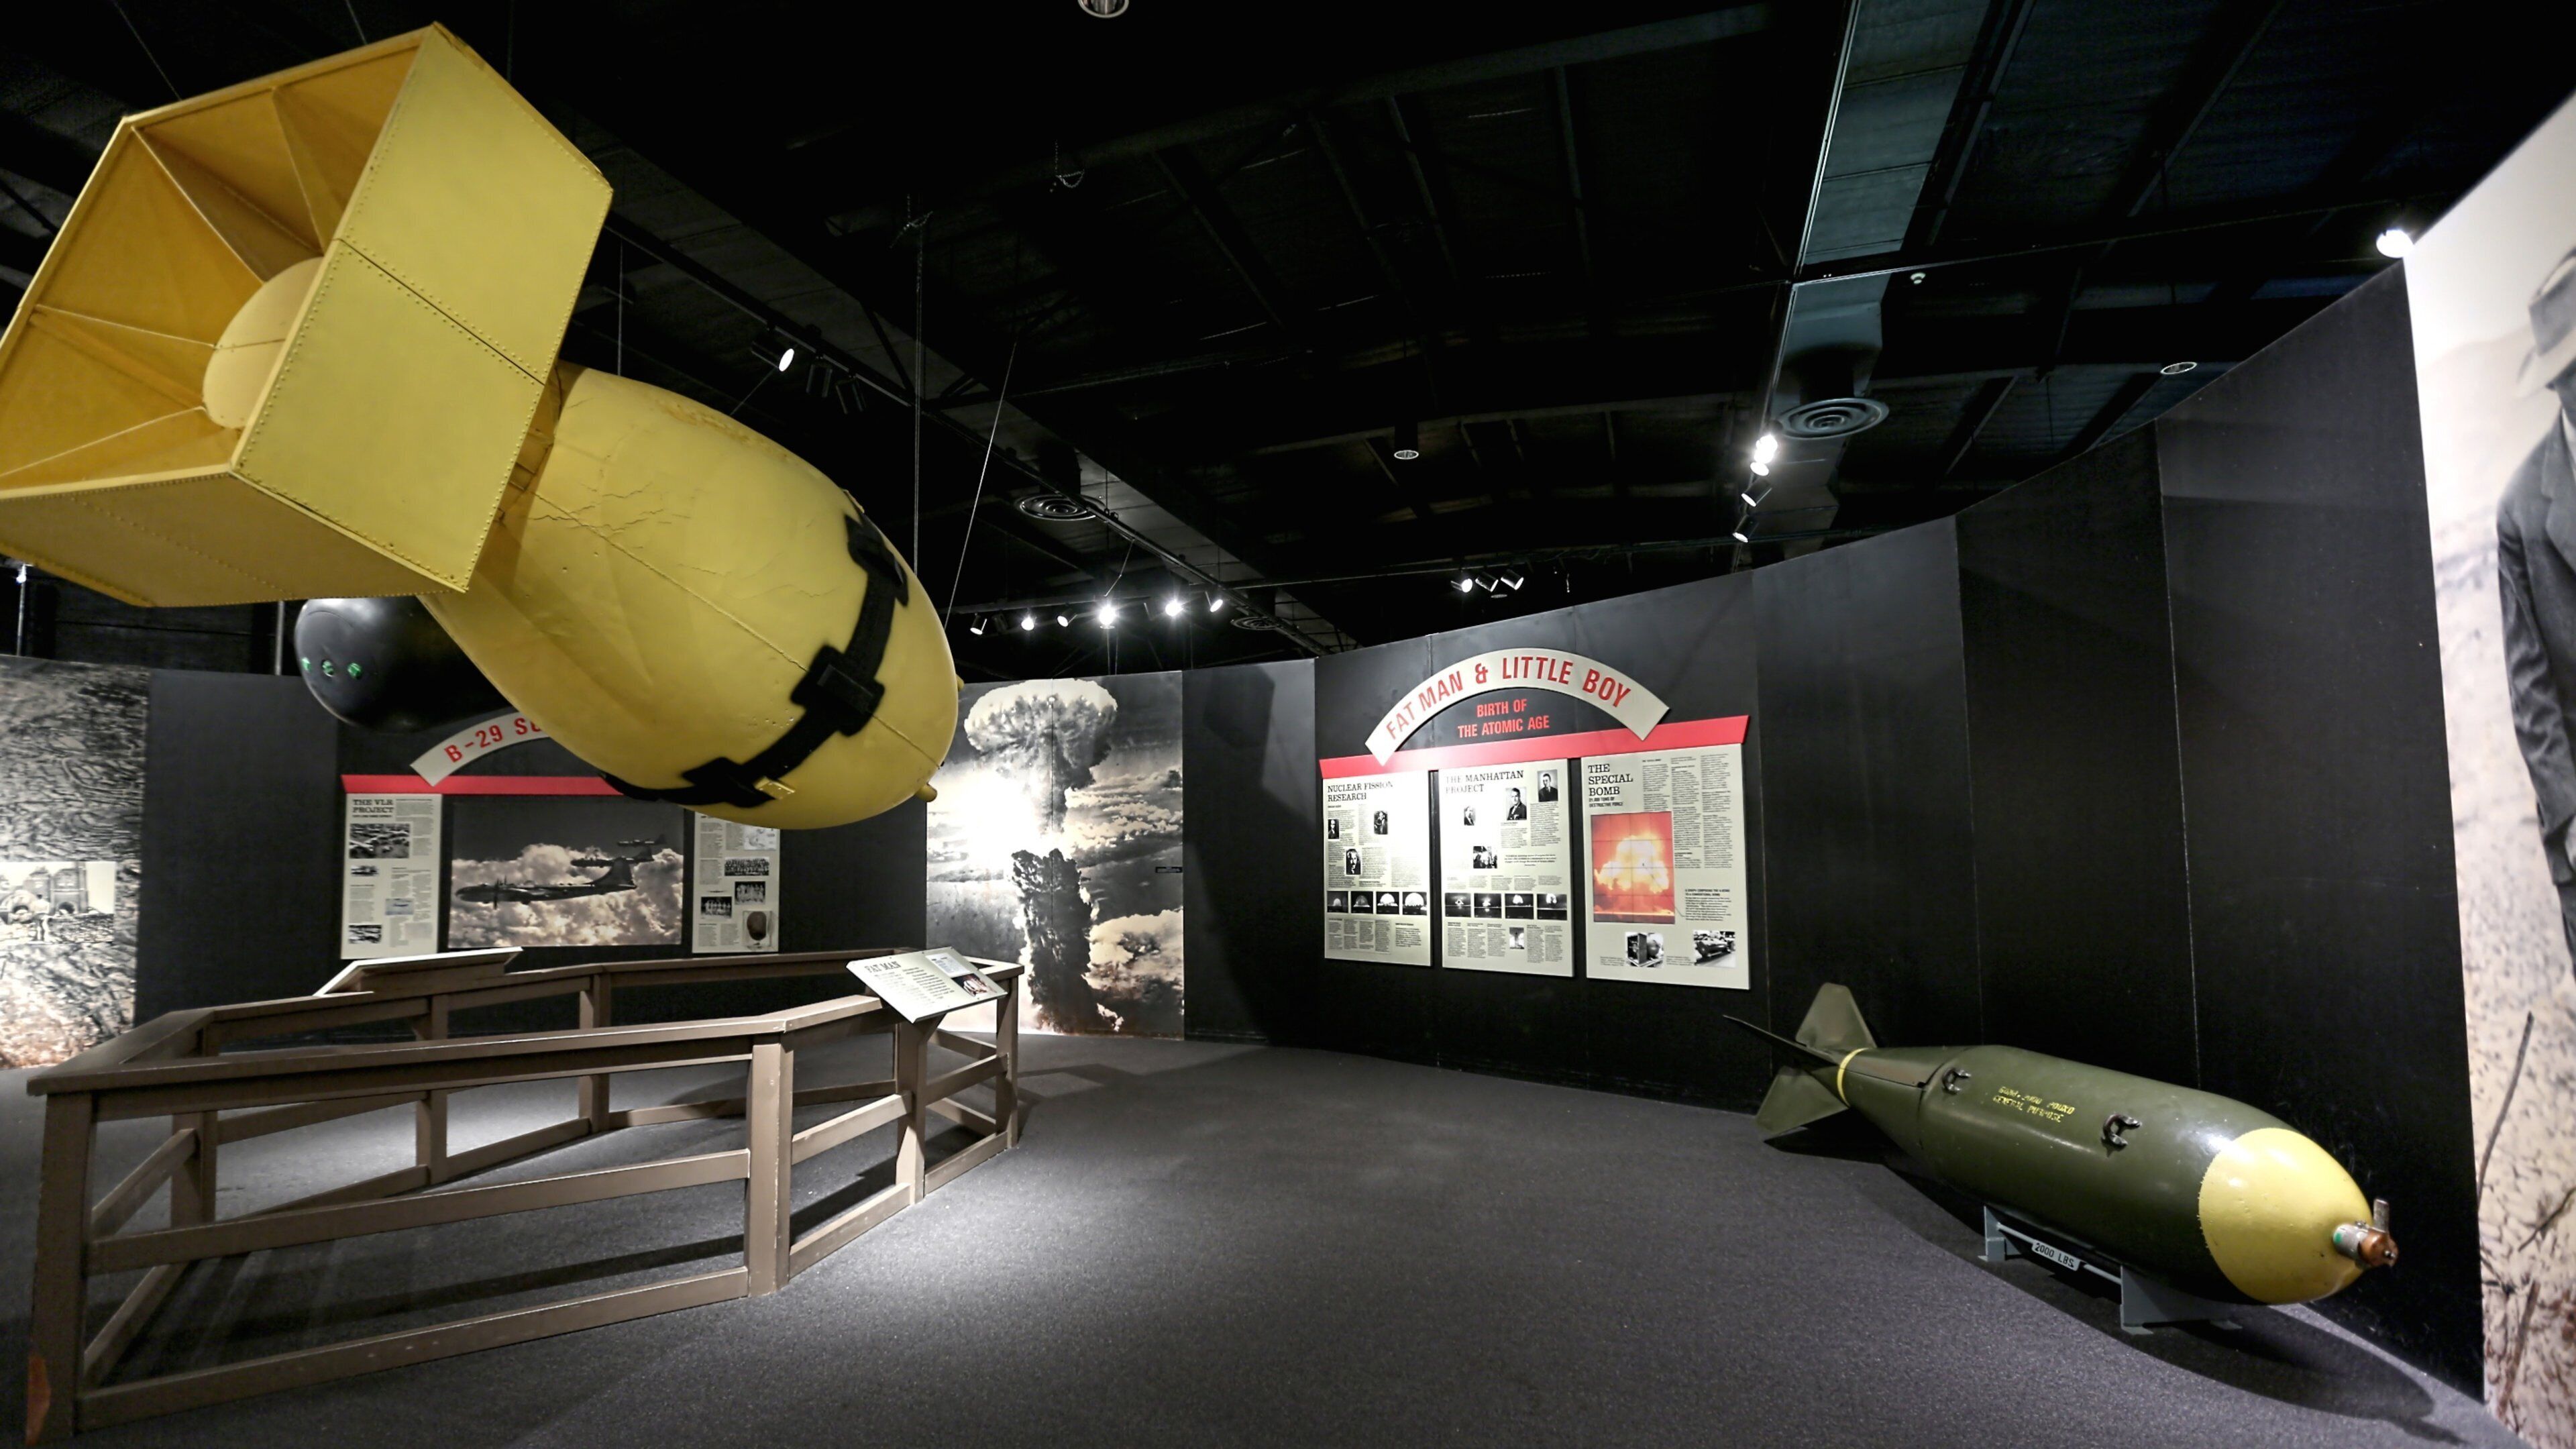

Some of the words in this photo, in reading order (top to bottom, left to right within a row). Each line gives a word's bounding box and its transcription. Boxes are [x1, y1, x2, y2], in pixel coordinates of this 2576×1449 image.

[1385, 701, 1416, 740] FAT
[1417, 671, 1464, 709] MAN
[1475, 663, 1488, 684] &
[1502, 657, 1574, 685] LITTLE
[1582, 669, 1632, 708] BOY
[1477, 701, 1509, 718] BIRTH
[1513, 699, 1527, 713] OF
[1458, 724, 1477, 738] THE
[1481, 720, 1523, 736] ATOMIC
[1527, 716, 1550, 729] AGE
[444, 724, 502, 762] B-29
[1589, 763, 1610, 773] THE
[1446, 775, 1464, 784] THE
[1465, 770, 1523, 782] MANHATTAN
[1589, 773, 1633, 785] SPECIAL
[1328, 783, 1362, 793] NUCLEAR
[1364, 781, 1393, 790] FISSION
[1445, 784, 1484, 794] PROJECT
[1589, 786, 1620, 796] BOMB
[1328, 792, 1366, 802] RESEARCH
[865, 964, 881, 973] FAT
[881, 961, 902, 970] MAN
[2035, 1242, 2054, 1257] 2000
